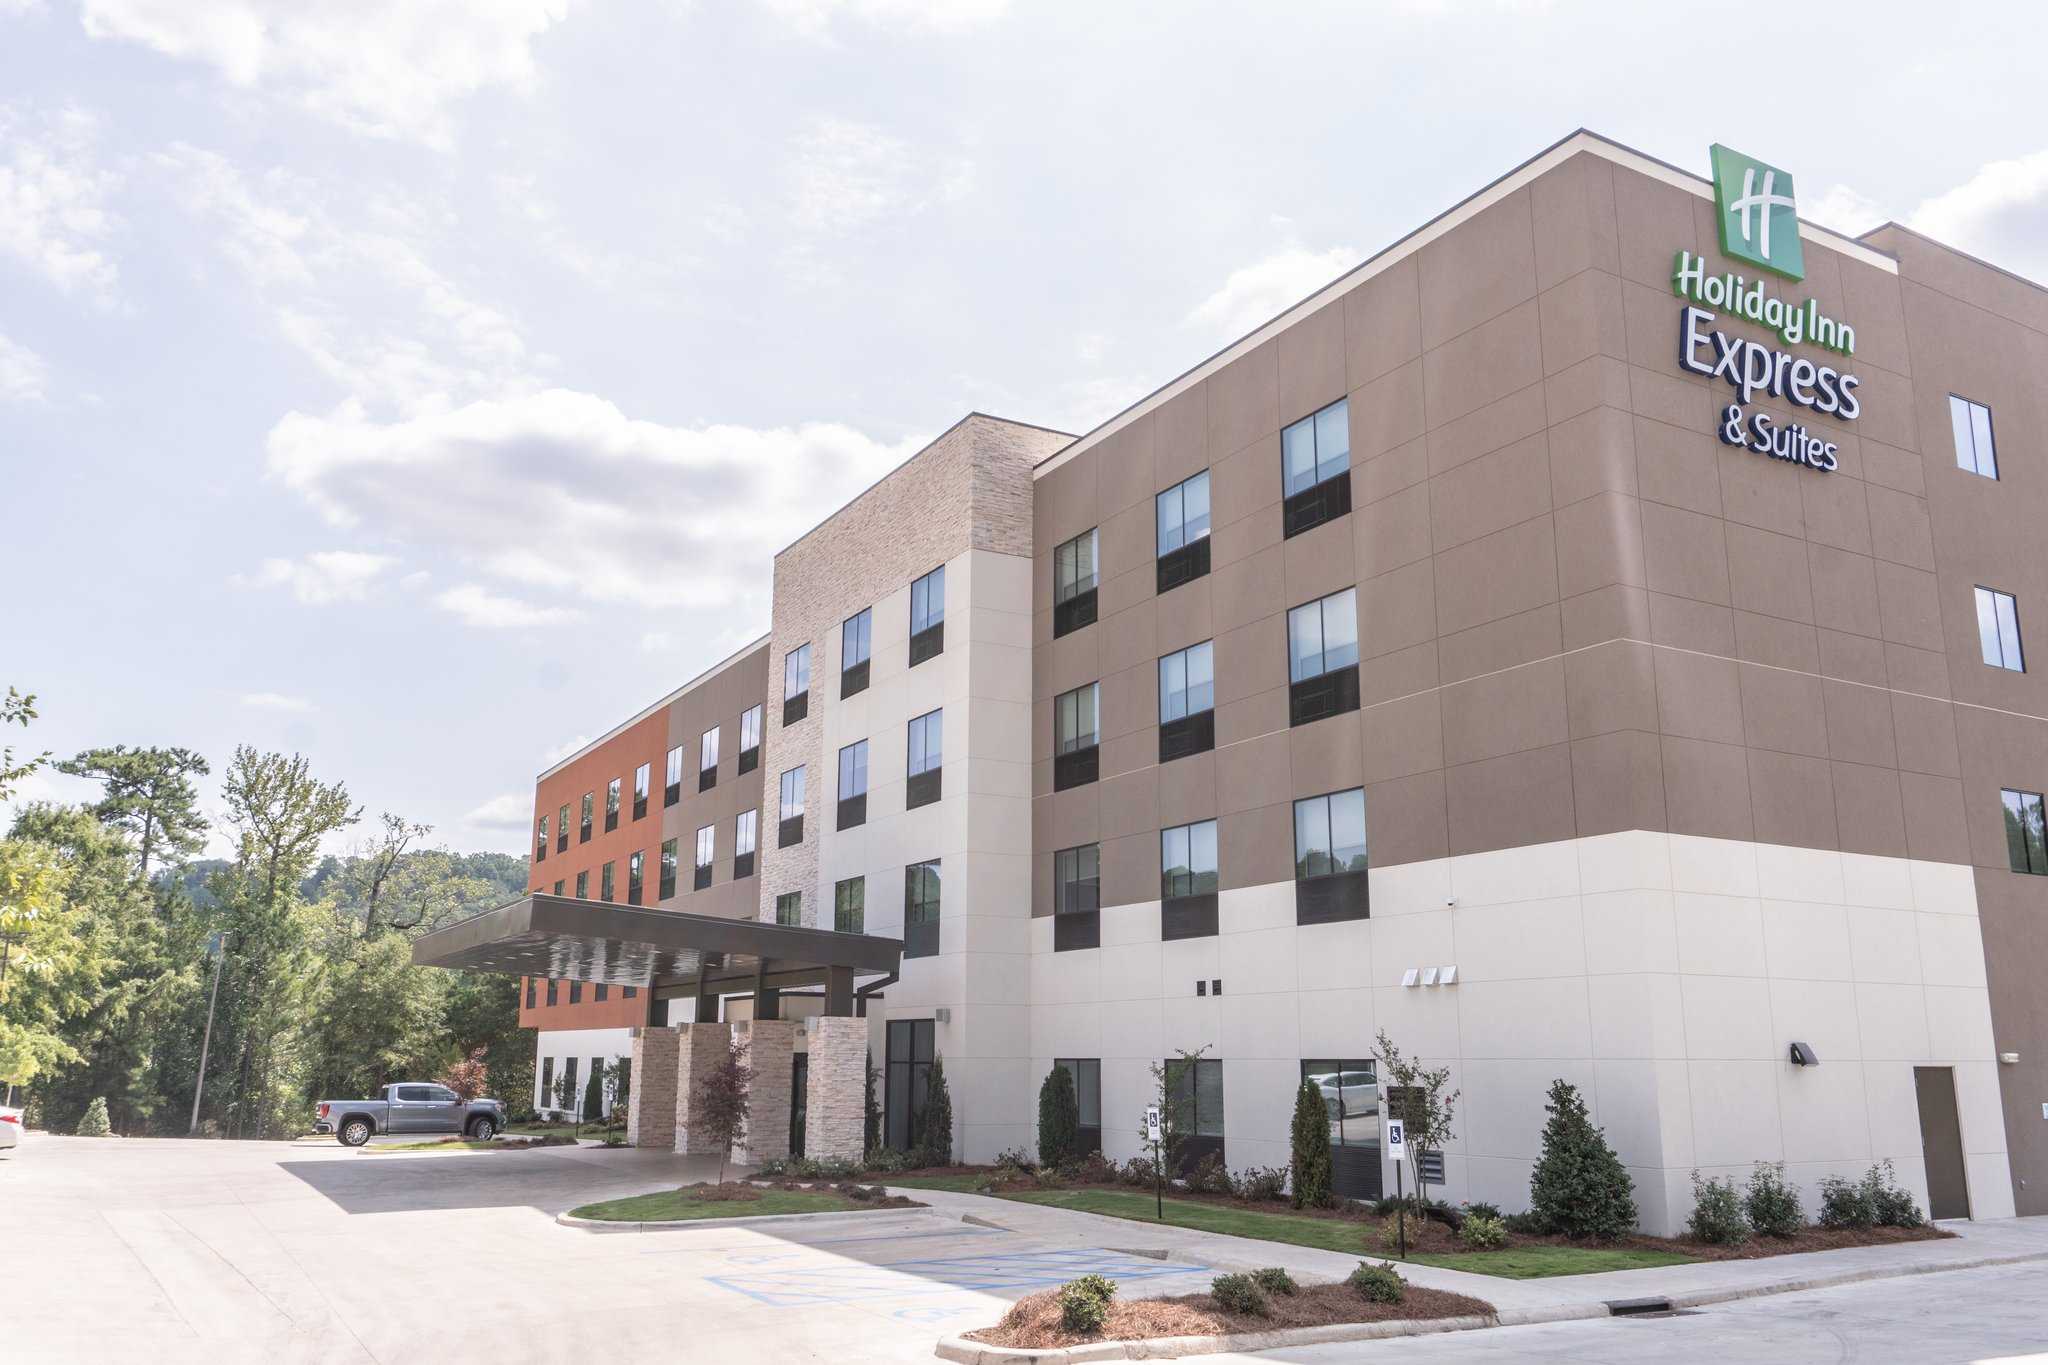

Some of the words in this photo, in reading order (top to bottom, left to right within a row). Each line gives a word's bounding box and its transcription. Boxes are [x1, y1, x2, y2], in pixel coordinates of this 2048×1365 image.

[1730, 168, 1796, 260] H
[1675, 250, 1803, 345] Holiday
[1806, 298, 1855, 354] Inn
[1681, 306, 1860, 420] Express
[1721, 404, 1748, 446] &
[1751, 413, 1839, 471] Suites
